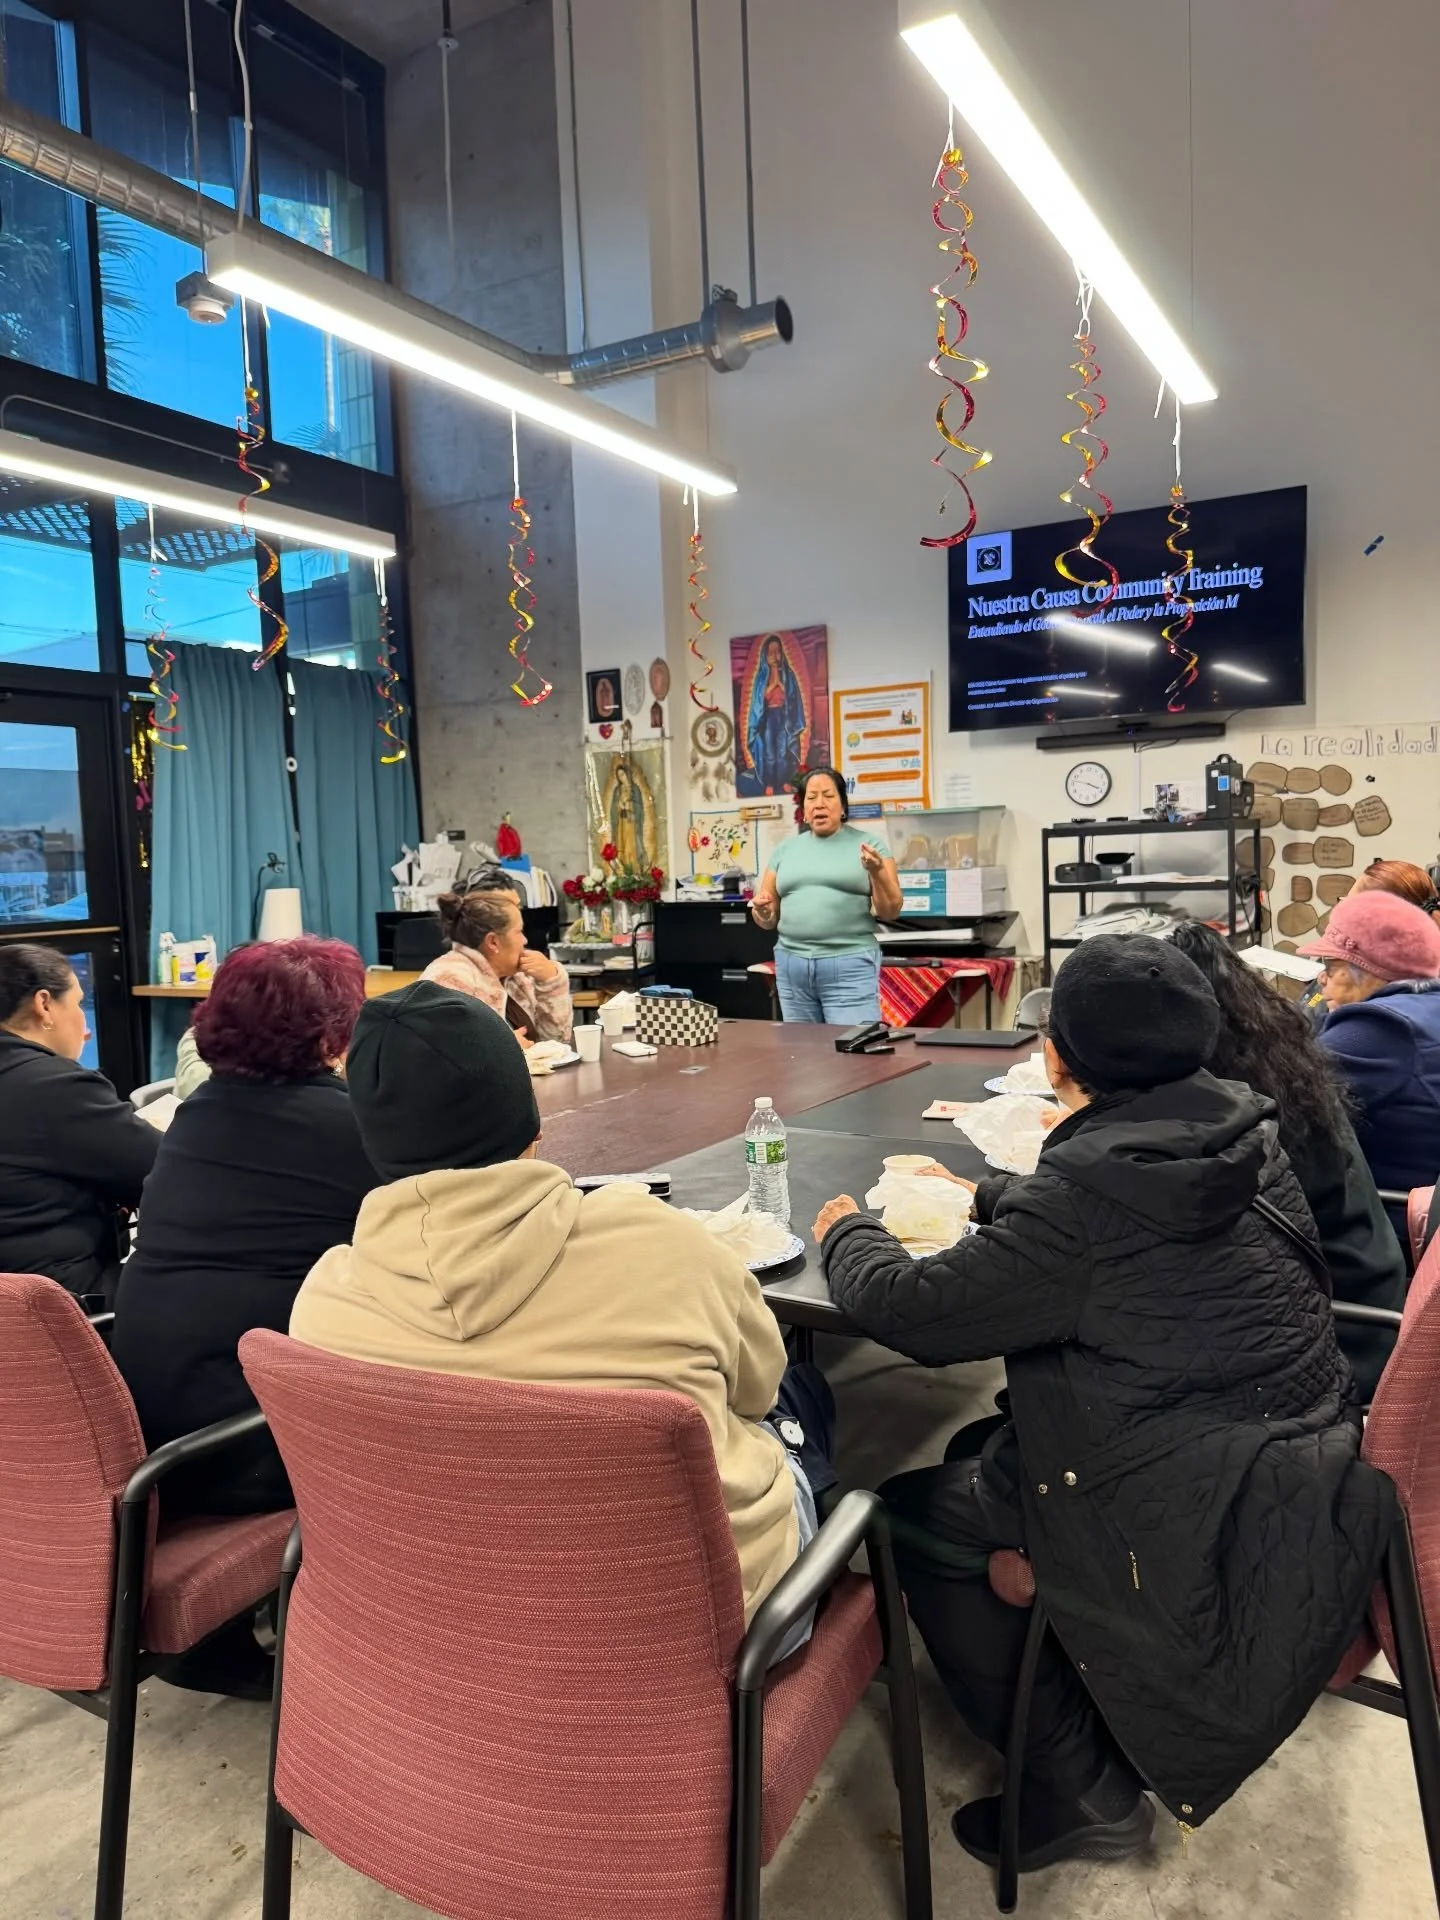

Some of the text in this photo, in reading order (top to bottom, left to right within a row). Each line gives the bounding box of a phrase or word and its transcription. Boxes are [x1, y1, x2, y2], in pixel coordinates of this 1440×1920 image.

[968, 594, 1030, 618] Nuestra
[1031, 588, 1081, 610] Causa
[1184, 562, 1264, 591] Training
[968, 619, 1022, 639] Entendiendo
[1107, 606, 1116, 621] el
[1117, 603, 1146, 621] Poder
[1143, 607, 1154, 621] y
[1153, 602, 1164, 617] la
[1164, 595, 1225, 617] Propsición
[1225, 593, 1240, 609] M
[1261, 726, 1439, 757] La realidad
